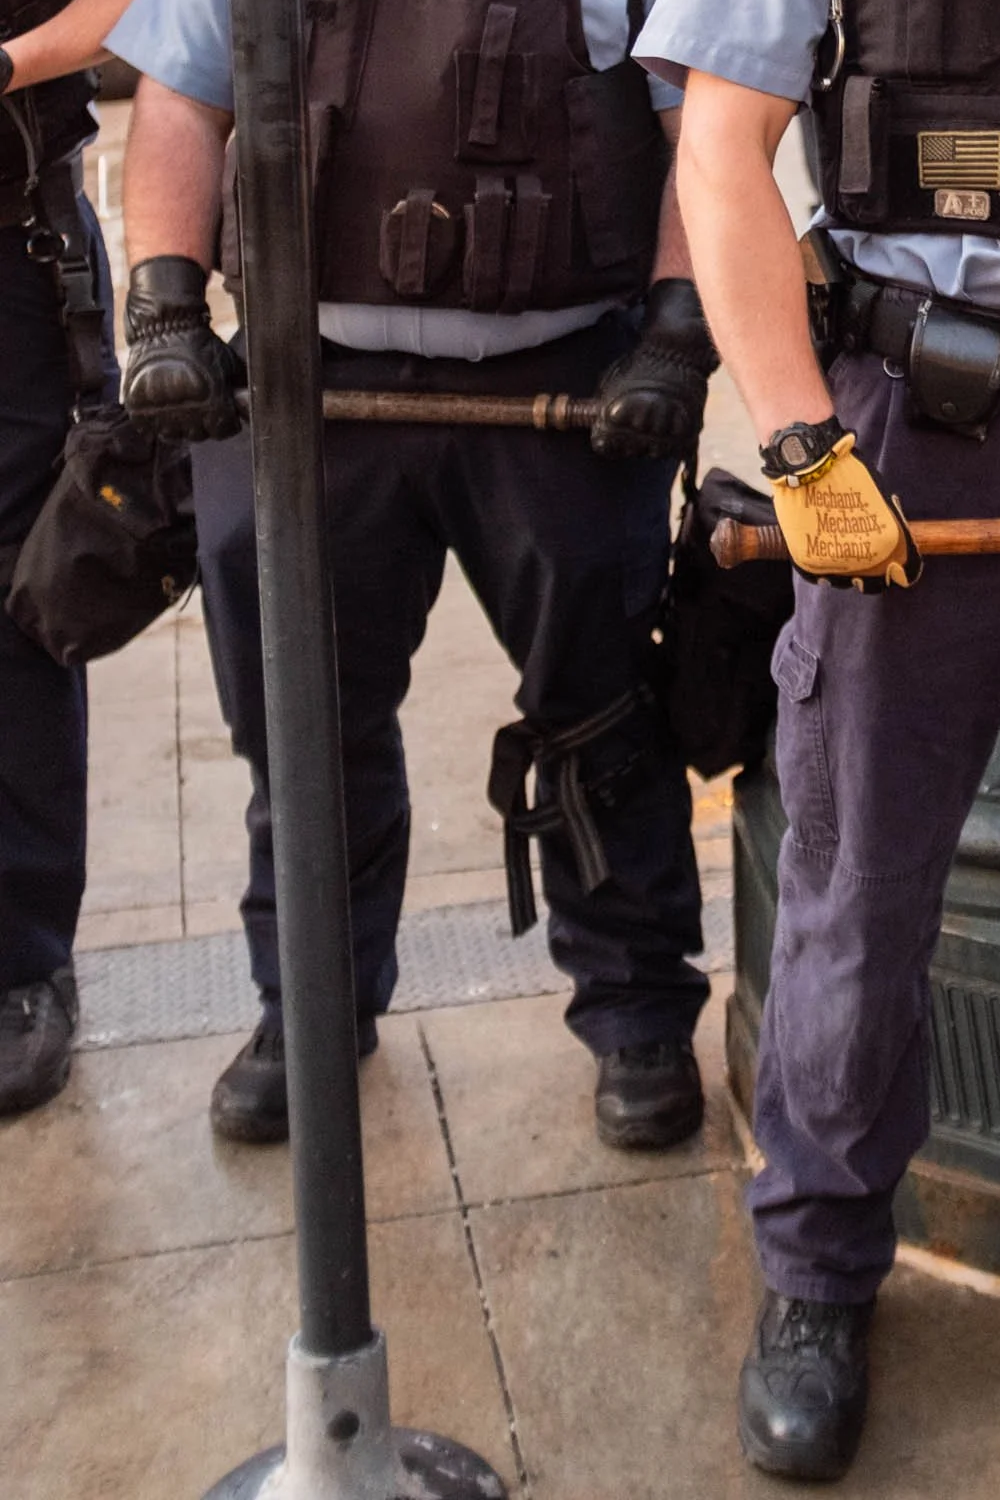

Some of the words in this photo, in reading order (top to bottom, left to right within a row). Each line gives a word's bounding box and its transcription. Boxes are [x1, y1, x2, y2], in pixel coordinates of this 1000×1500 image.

[805, 483, 865, 512] Mechanix
[816, 508, 881, 535] Mechanix
[806, 533, 873, 561] Mechanix
